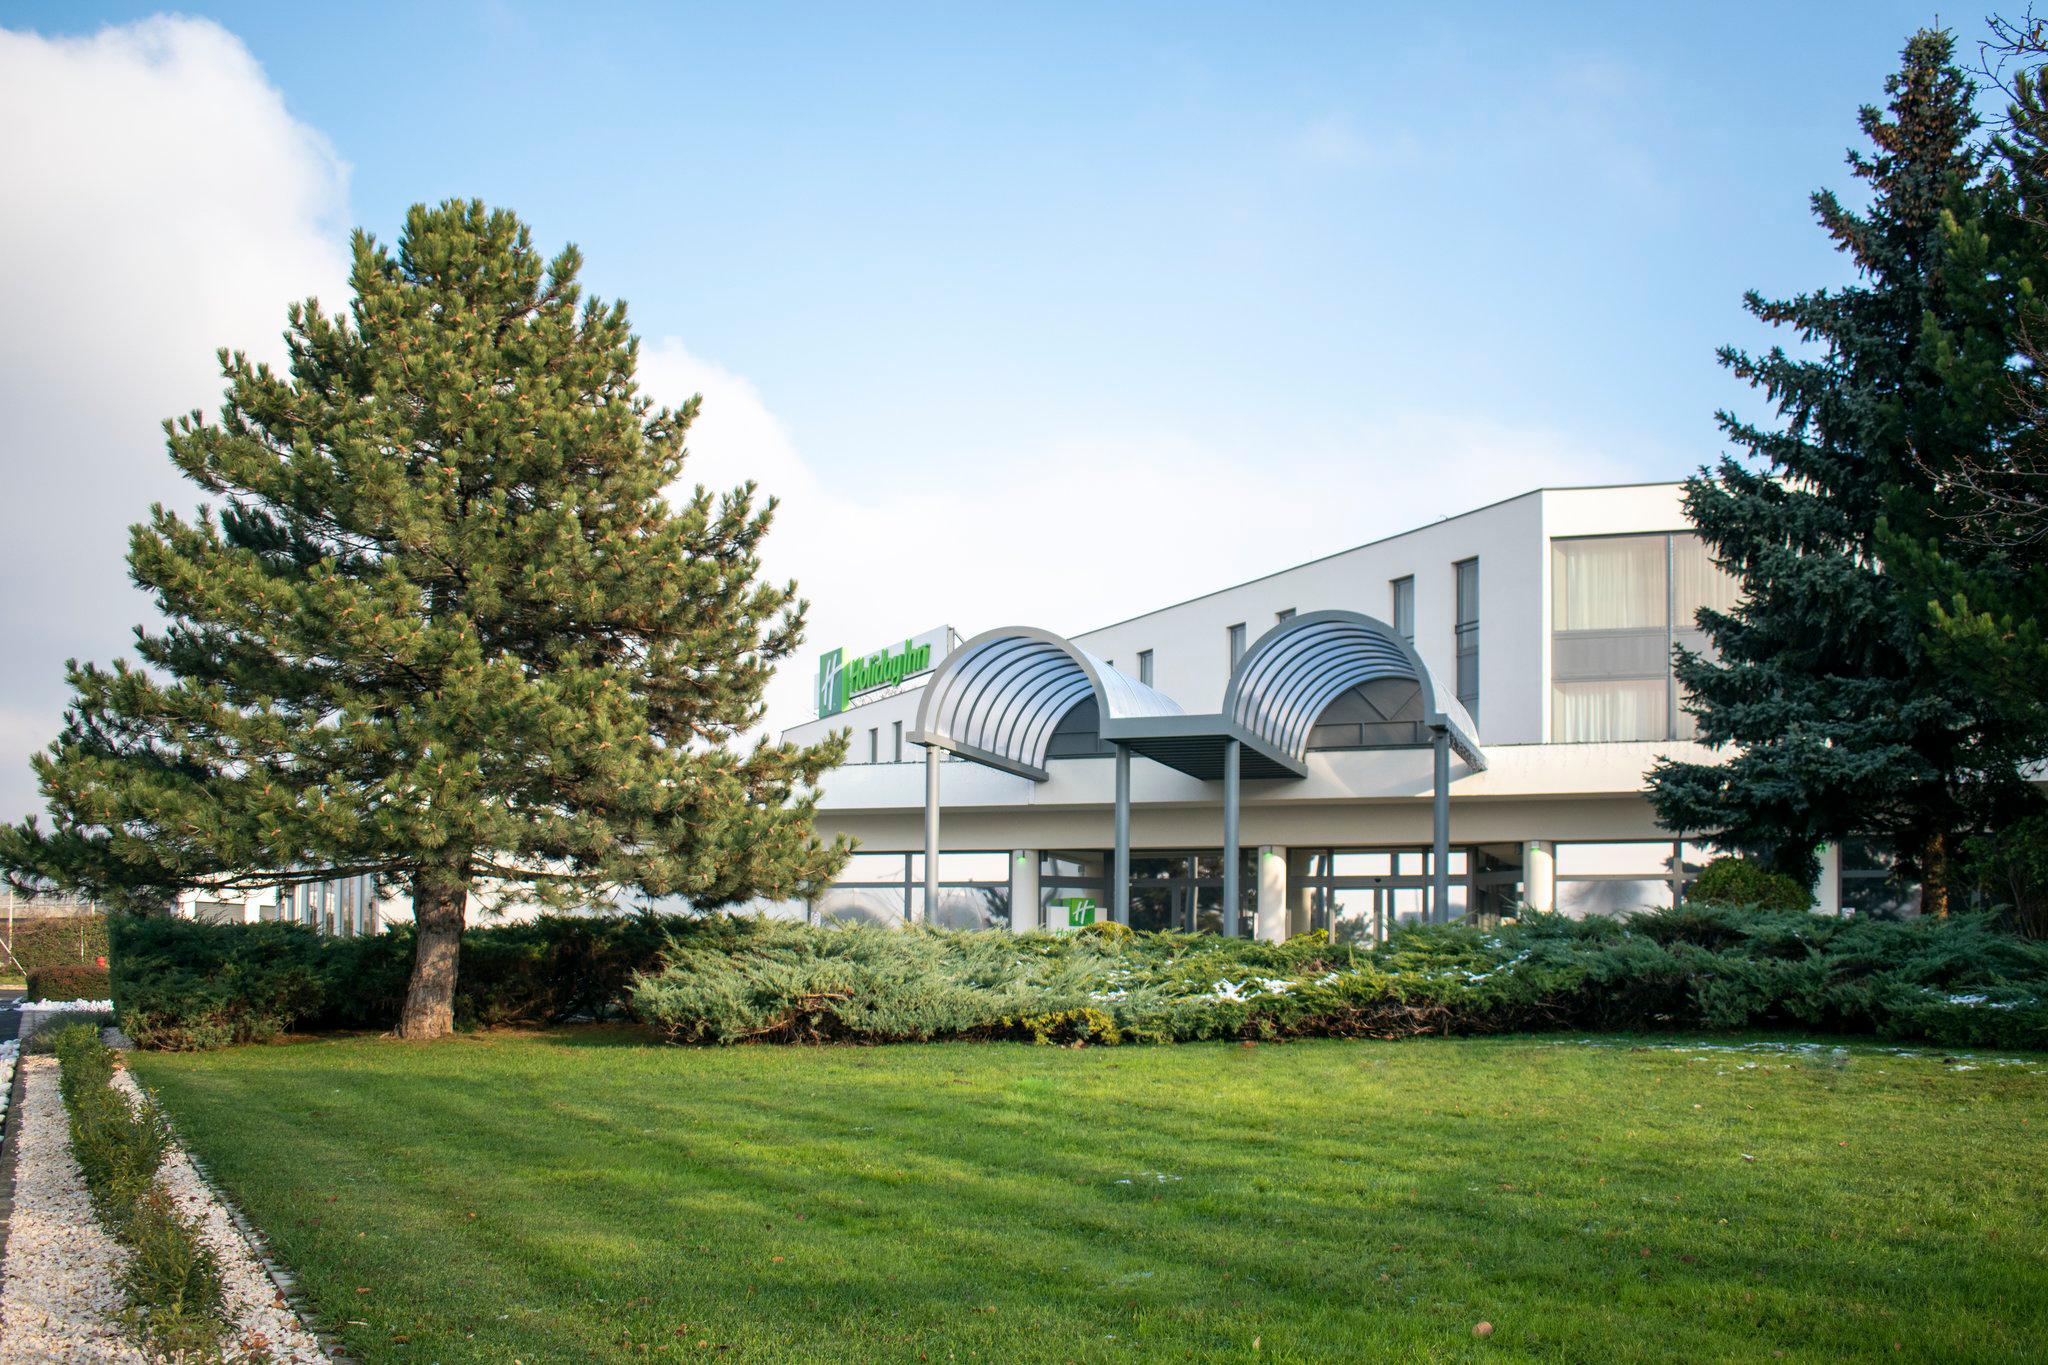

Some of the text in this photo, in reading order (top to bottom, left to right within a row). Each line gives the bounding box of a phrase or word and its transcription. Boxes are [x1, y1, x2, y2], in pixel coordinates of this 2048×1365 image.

[849, 638, 931, 693] Holiday Inn
[1072, 899, 1095, 924] H
